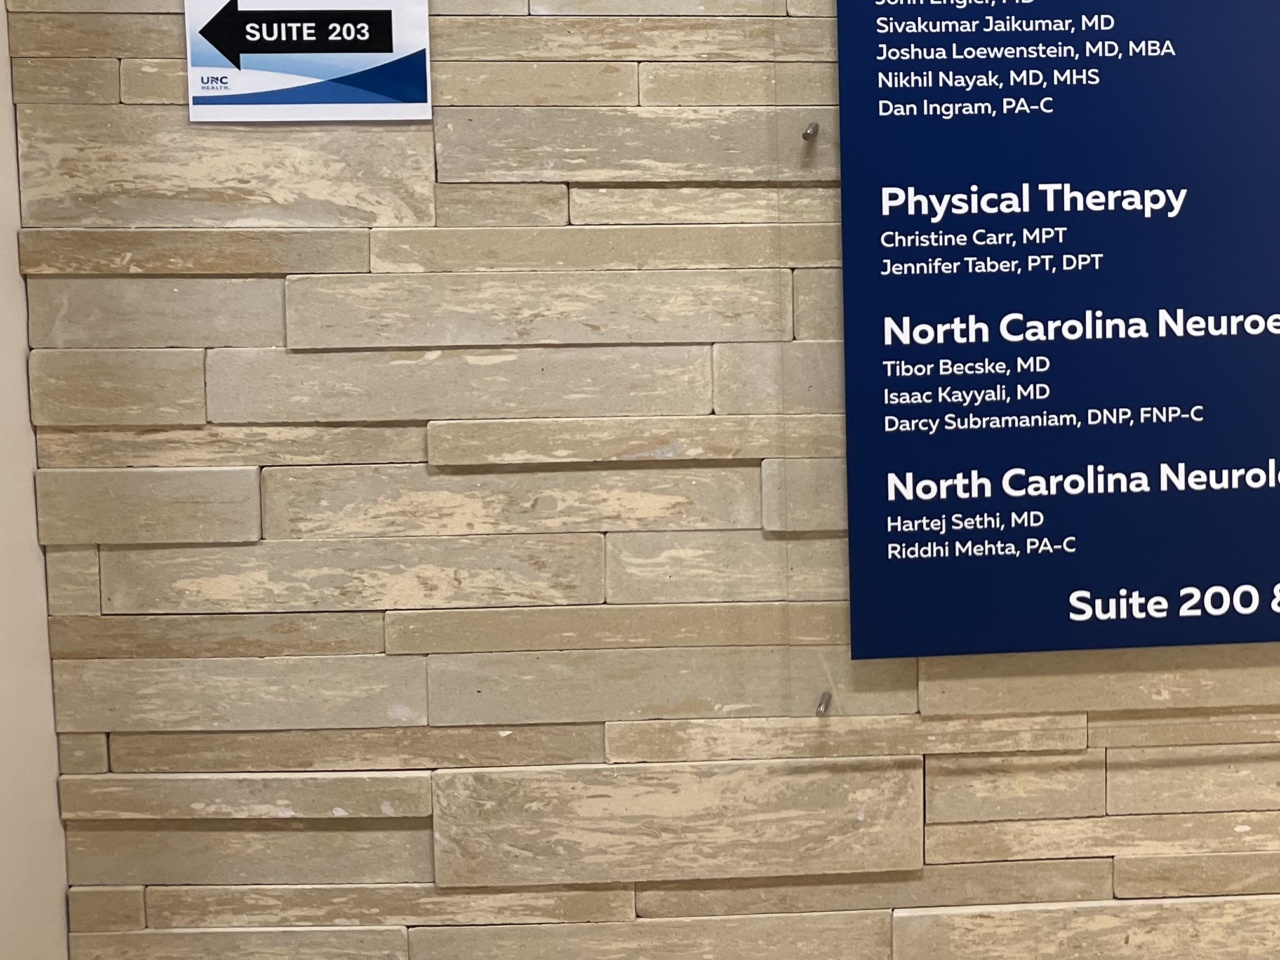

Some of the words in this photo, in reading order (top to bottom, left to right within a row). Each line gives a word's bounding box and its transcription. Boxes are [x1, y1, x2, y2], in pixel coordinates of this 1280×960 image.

[245, 22, 317, 42] SUITE
[328, 22, 370, 41] 203
[876, 16, 980, 34] Sivakumar
[982, 15, 1076, 34] Jaikumar,
[1081, 14, 1115, 31] MD
[876, 43, 948, 61] Joshua
[952, 41, 1080, 61] Loewenstein,
[1085, 40, 1123, 60] MD,
[1128, 40, 1176, 57] MBA
[200, 76, 229, 85] UNC
[878, 70, 933, 88] Nikhil
[938, 70, 1004, 92] Nayak,
[1009, 69, 1048, 89] MD,
[1053, 68, 1100, 85] MHS
[878, 99, 918, 116] Dan
[923, 99, 997, 120] Ingram,
[1002, 96, 1054, 114] PA-C
[881, 182, 1030, 224] Physical
[1038, 183, 1188, 218] Therapy
[880, 230, 968, 248] Christine
[972, 228, 1017, 248] Carr,
[1022, 226, 1068, 244] MPT
[880, 257, 961, 276] Jennifer
[963, 256, 1022, 275] Taber,
[1027, 254, 1057, 274] PT,
[1062, 253, 1104, 271] DPT
[884, 314, 989, 346] North
[999, 309, 1149, 342] Carolina
[882, 360, 935, 377] Tibor
[939, 357, 1011, 377] Becske,
[1016, 356, 1051, 373] MD
[884, 388, 933, 405] Isaac
[938, 384, 1011, 407] Kayyali,
[1016, 383, 1050, 400] MD
[884, 415, 940, 435] Darcy
[944, 410, 1082, 430] Subramaniam,
[1087, 407, 1134, 427] DNP,
[1140, 405, 1204, 424] FNP-C
[887, 469, 992, 501] North
[1001, 464, 1151, 497] Carolina
[887, 514, 946, 535] Hartej
[951, 512, 1005, 531] Sethi,
[1011, 510, 1044, 528] MD
[887, 541, 949, 560] Riddhi
[955, 539, 1021, 558] Mehta,
[1026, 536, 1077, 555] PA-C
[1069, 588, 1169, 621] Suite
[1179, 584, 1260, 617] 200
